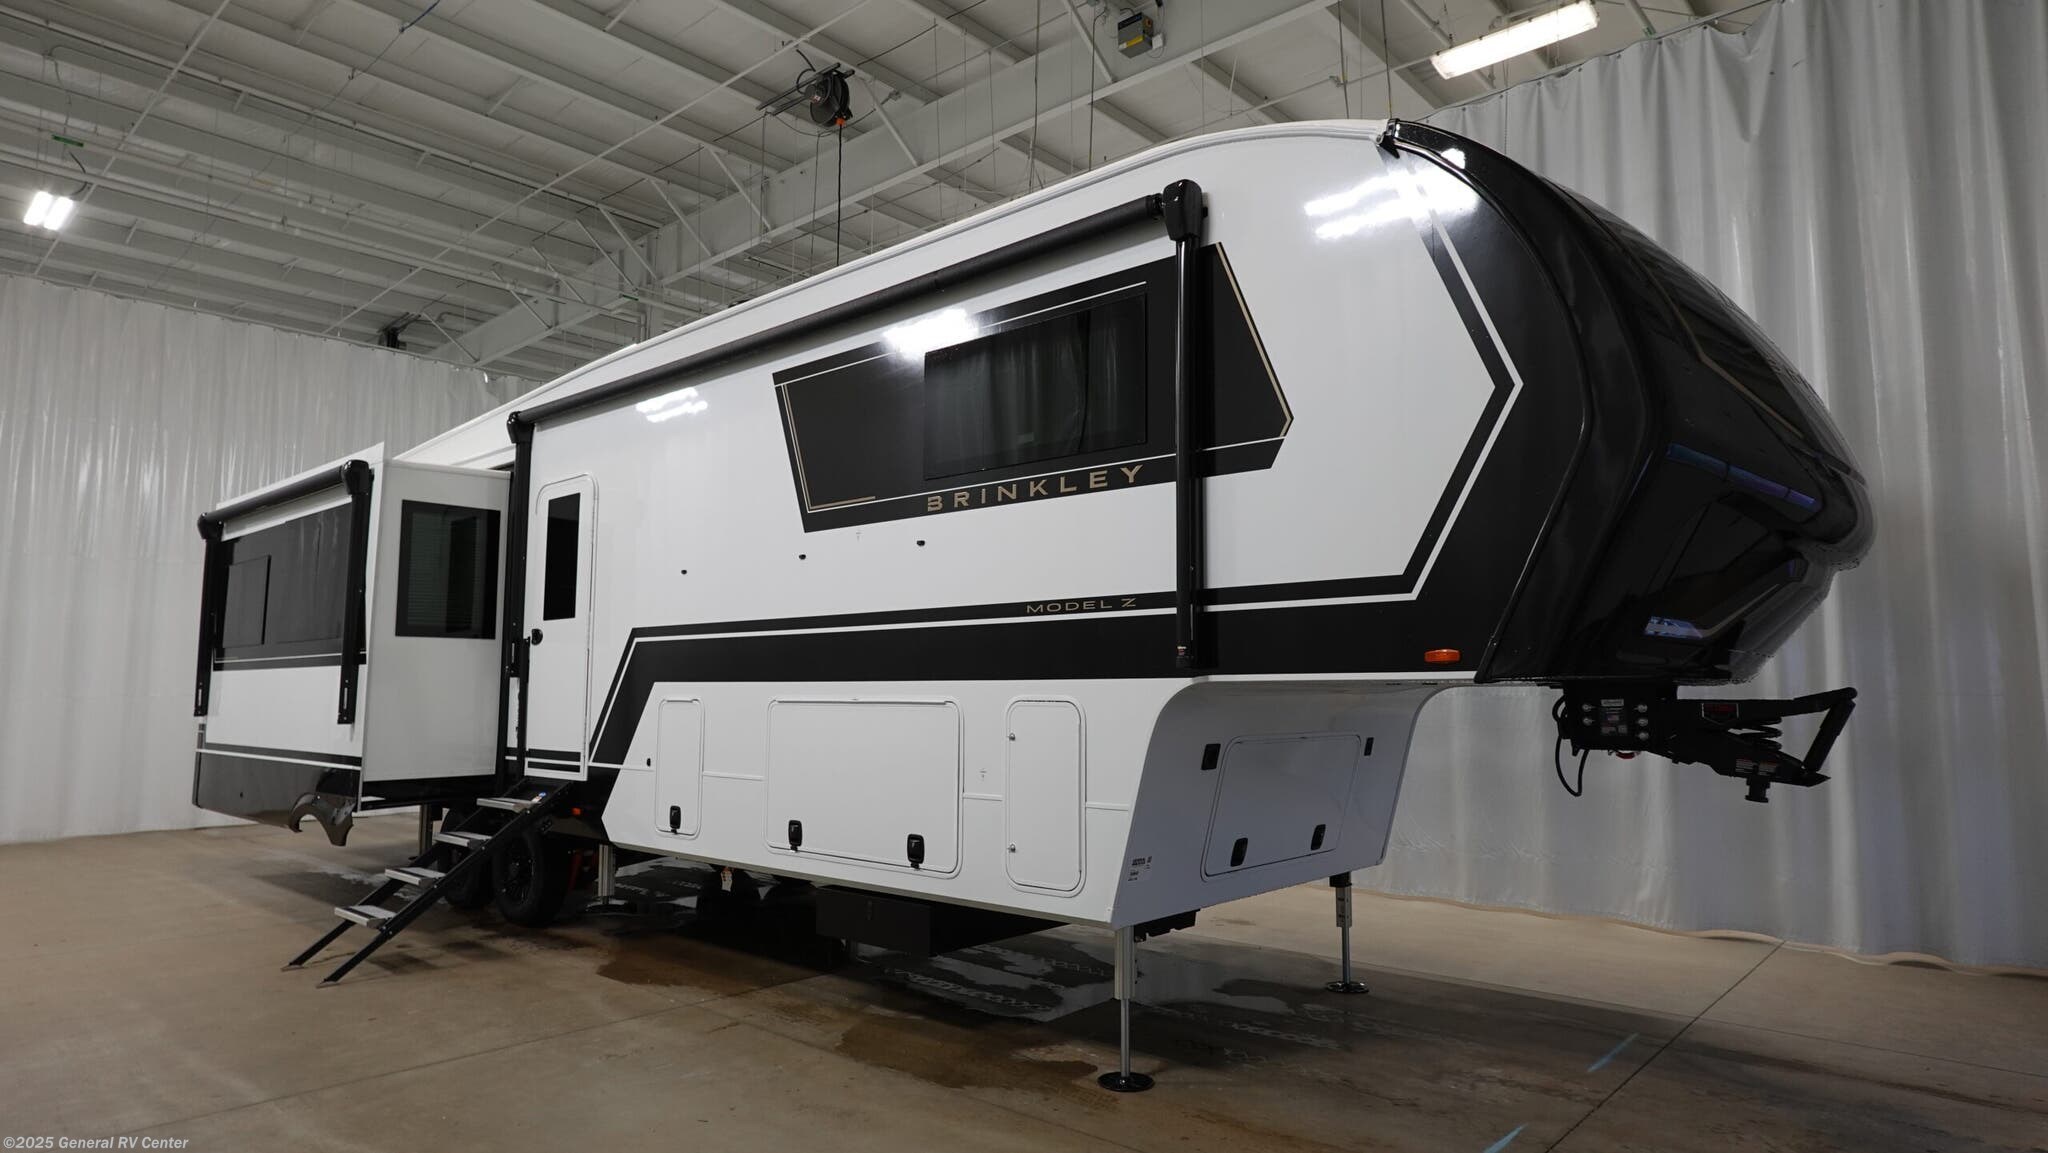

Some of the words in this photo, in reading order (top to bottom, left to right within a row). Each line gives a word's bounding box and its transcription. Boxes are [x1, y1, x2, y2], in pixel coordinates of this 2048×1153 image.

[927, 464, 1144, 512] BRINKLEY
[1026, 599, 1113, 614] MODEL
[1121, 597, 1137, 608] Z
